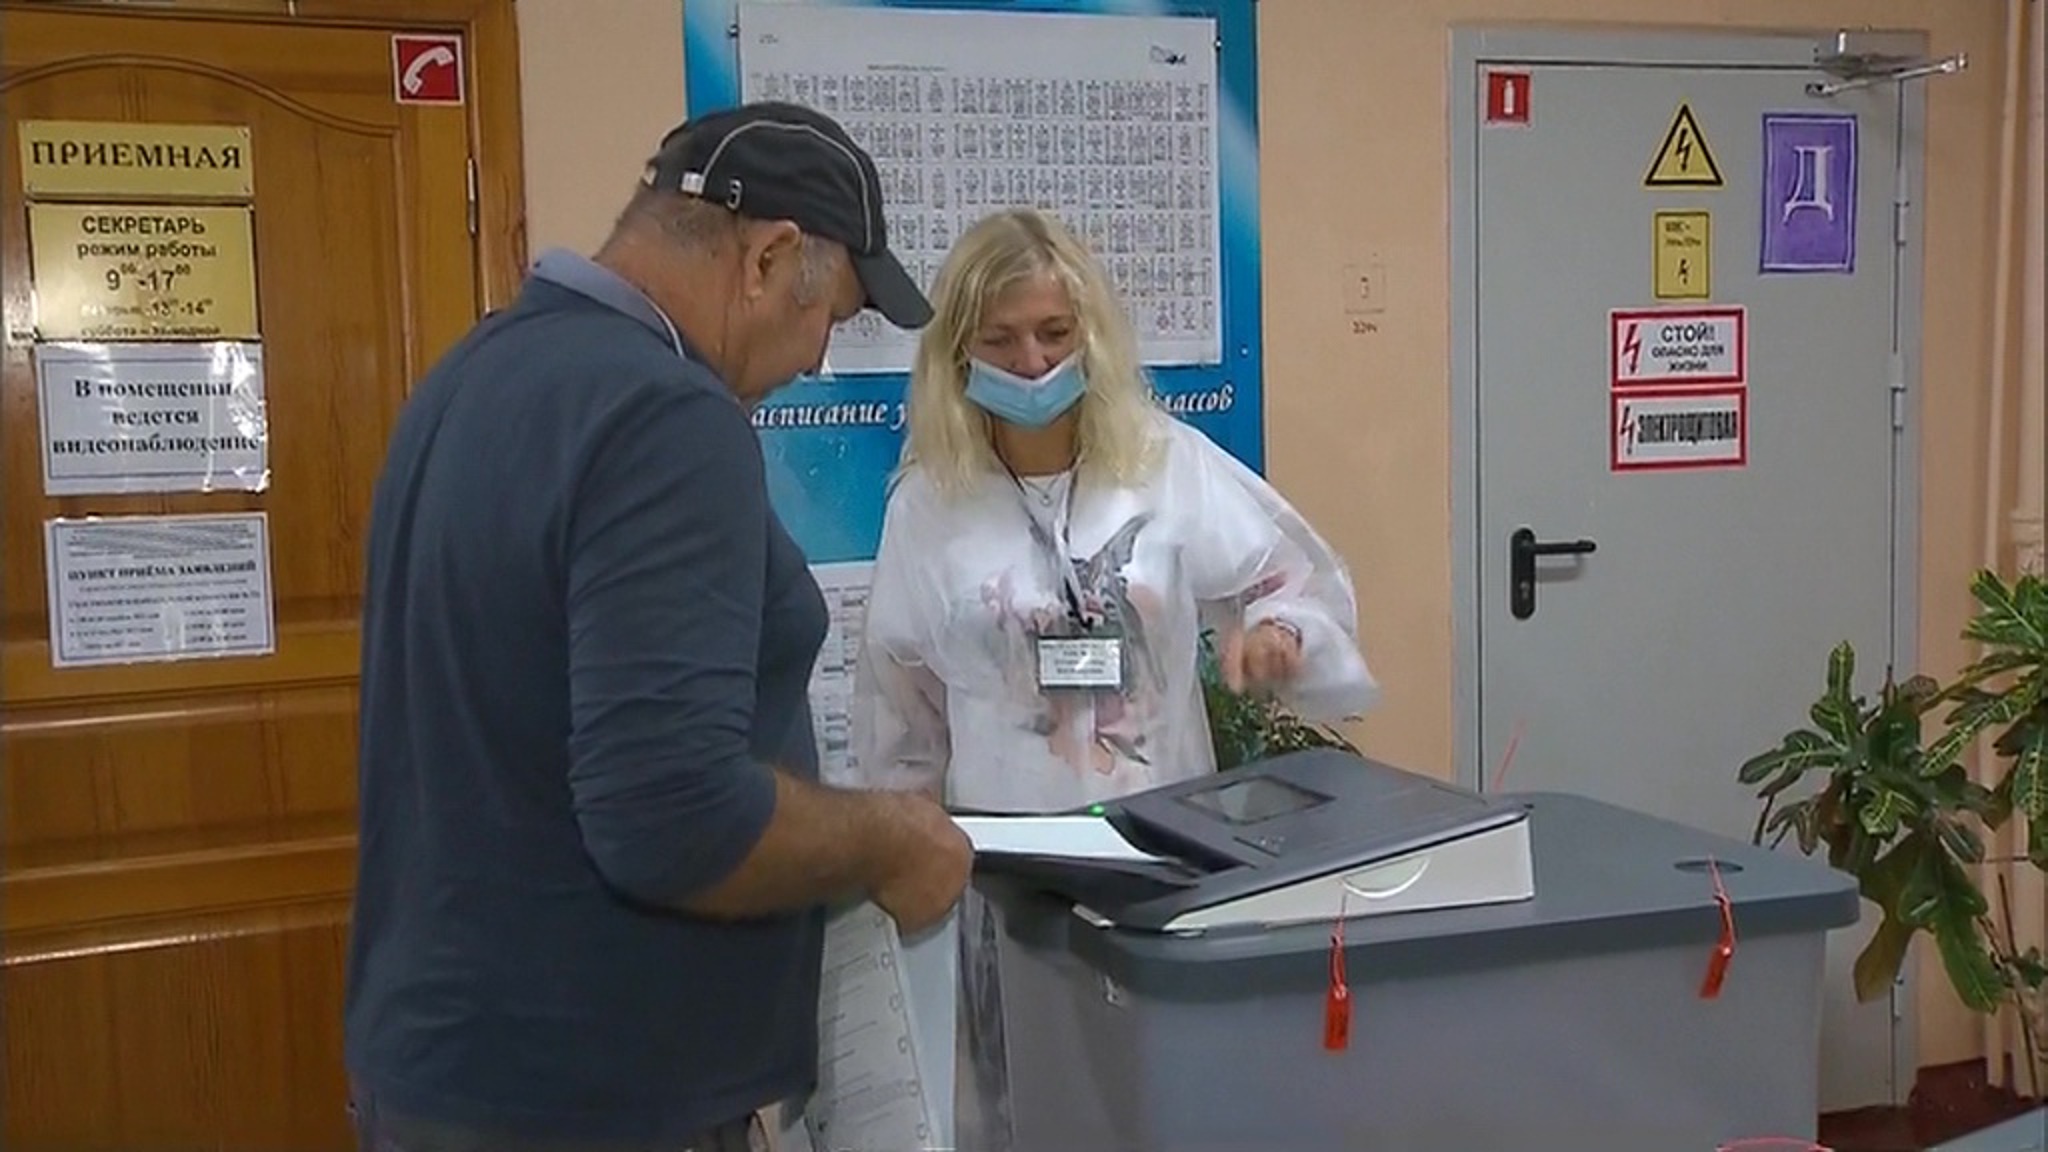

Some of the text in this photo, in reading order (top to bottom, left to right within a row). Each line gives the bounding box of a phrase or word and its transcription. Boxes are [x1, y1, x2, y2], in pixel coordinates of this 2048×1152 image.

[32, 141, 241, 169] ПРИЕМНАЯ
[1782, 146, 1834, 225] Д
[82, 216, 205, 234] СЕКРЕТАРЬ
[77, 240, 216, 260] режим работы
[1661, 322, 1715, 343] СТОЙ!
[1651, 345, 1724, 358] ОПАСНО ДЛЯ
[1669, 361, 1708, 372] ЖИЗНИ
[74, 379, 91, 398] В
[112, 409, 200, 426] ведется
[752, 402, 889, 427] асписание
[52, 433, 260, 457] видеонаблюдение
